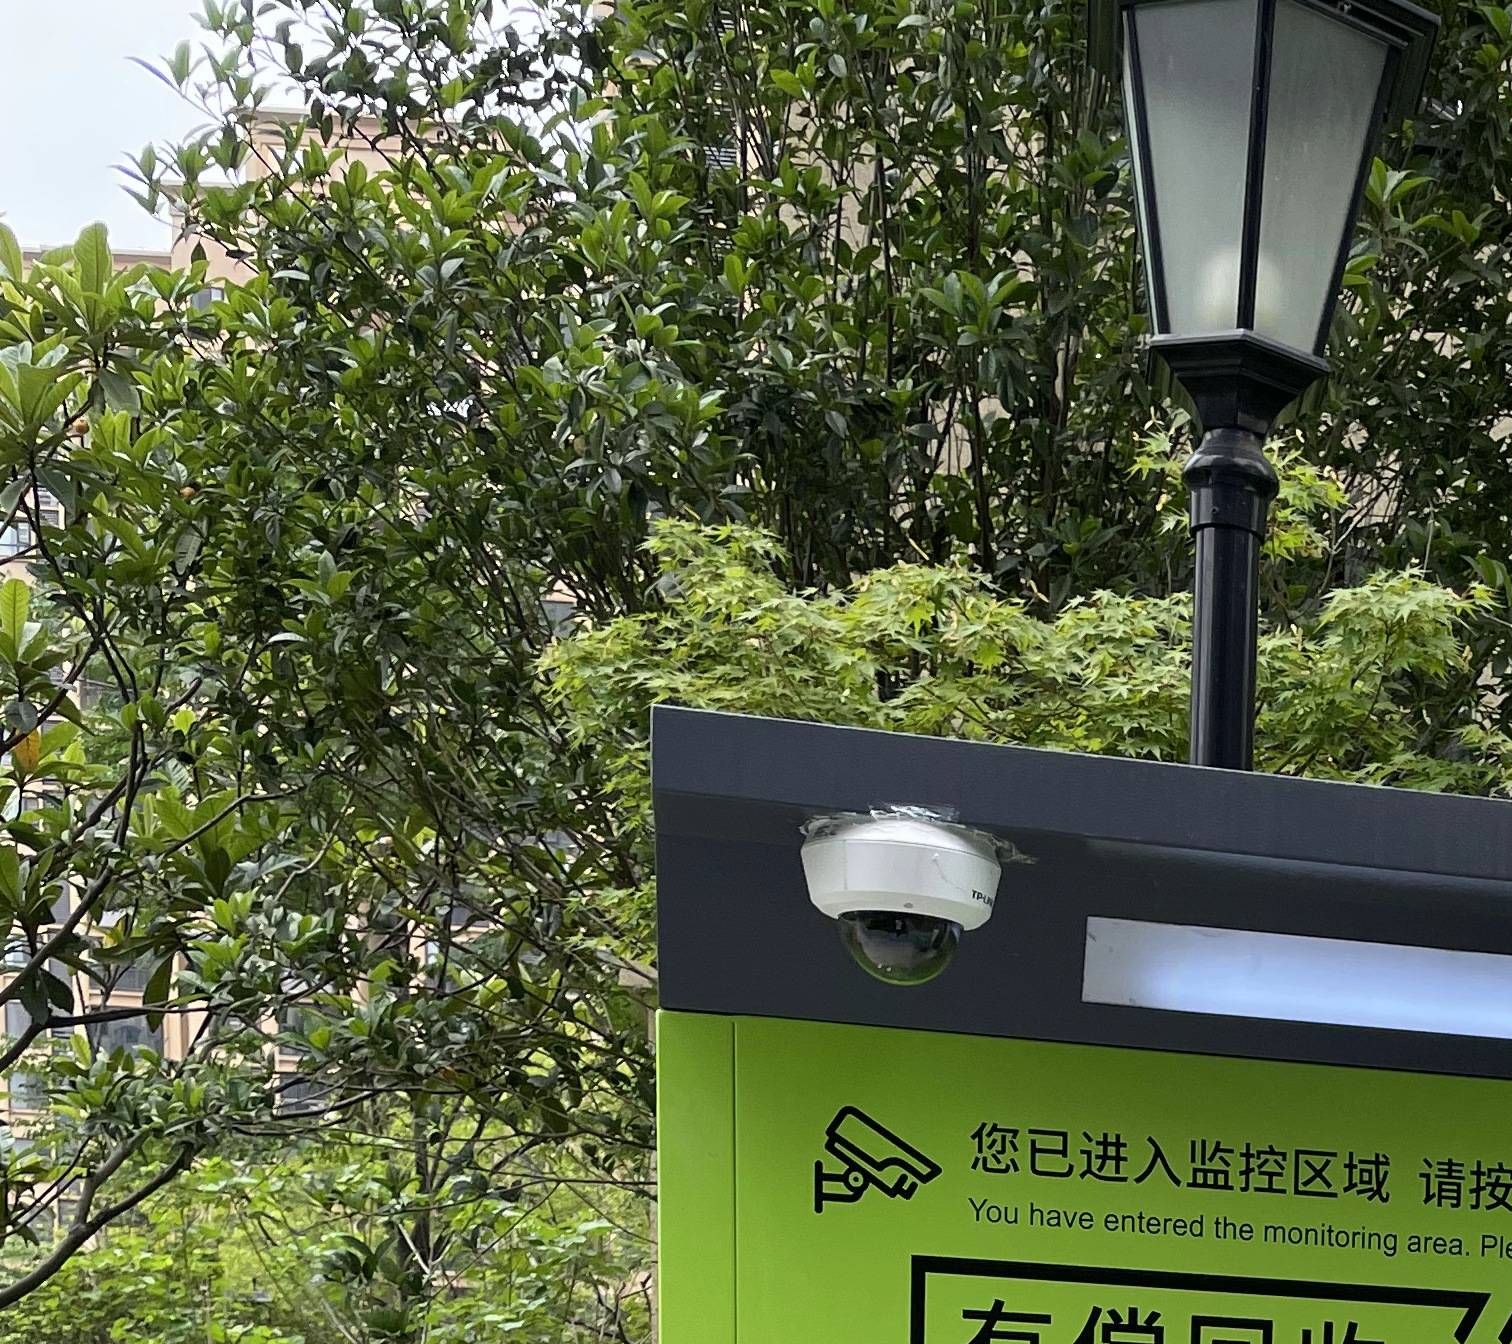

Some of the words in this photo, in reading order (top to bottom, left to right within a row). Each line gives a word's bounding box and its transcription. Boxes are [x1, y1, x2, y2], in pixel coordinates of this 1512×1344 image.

[968, 1121, 1391, 1204] 您已进入监控区域
[968, 1197, 1018, 1226] You
[1029, 1202, 1094, 1230] have
[1103, 1207, 1204, 1238] entered
[1213, 1216, 1254, 1241] the
[1263, 1219, 1398, 1257] monitoring
[1406, 1230, 1471, 1256] area.
